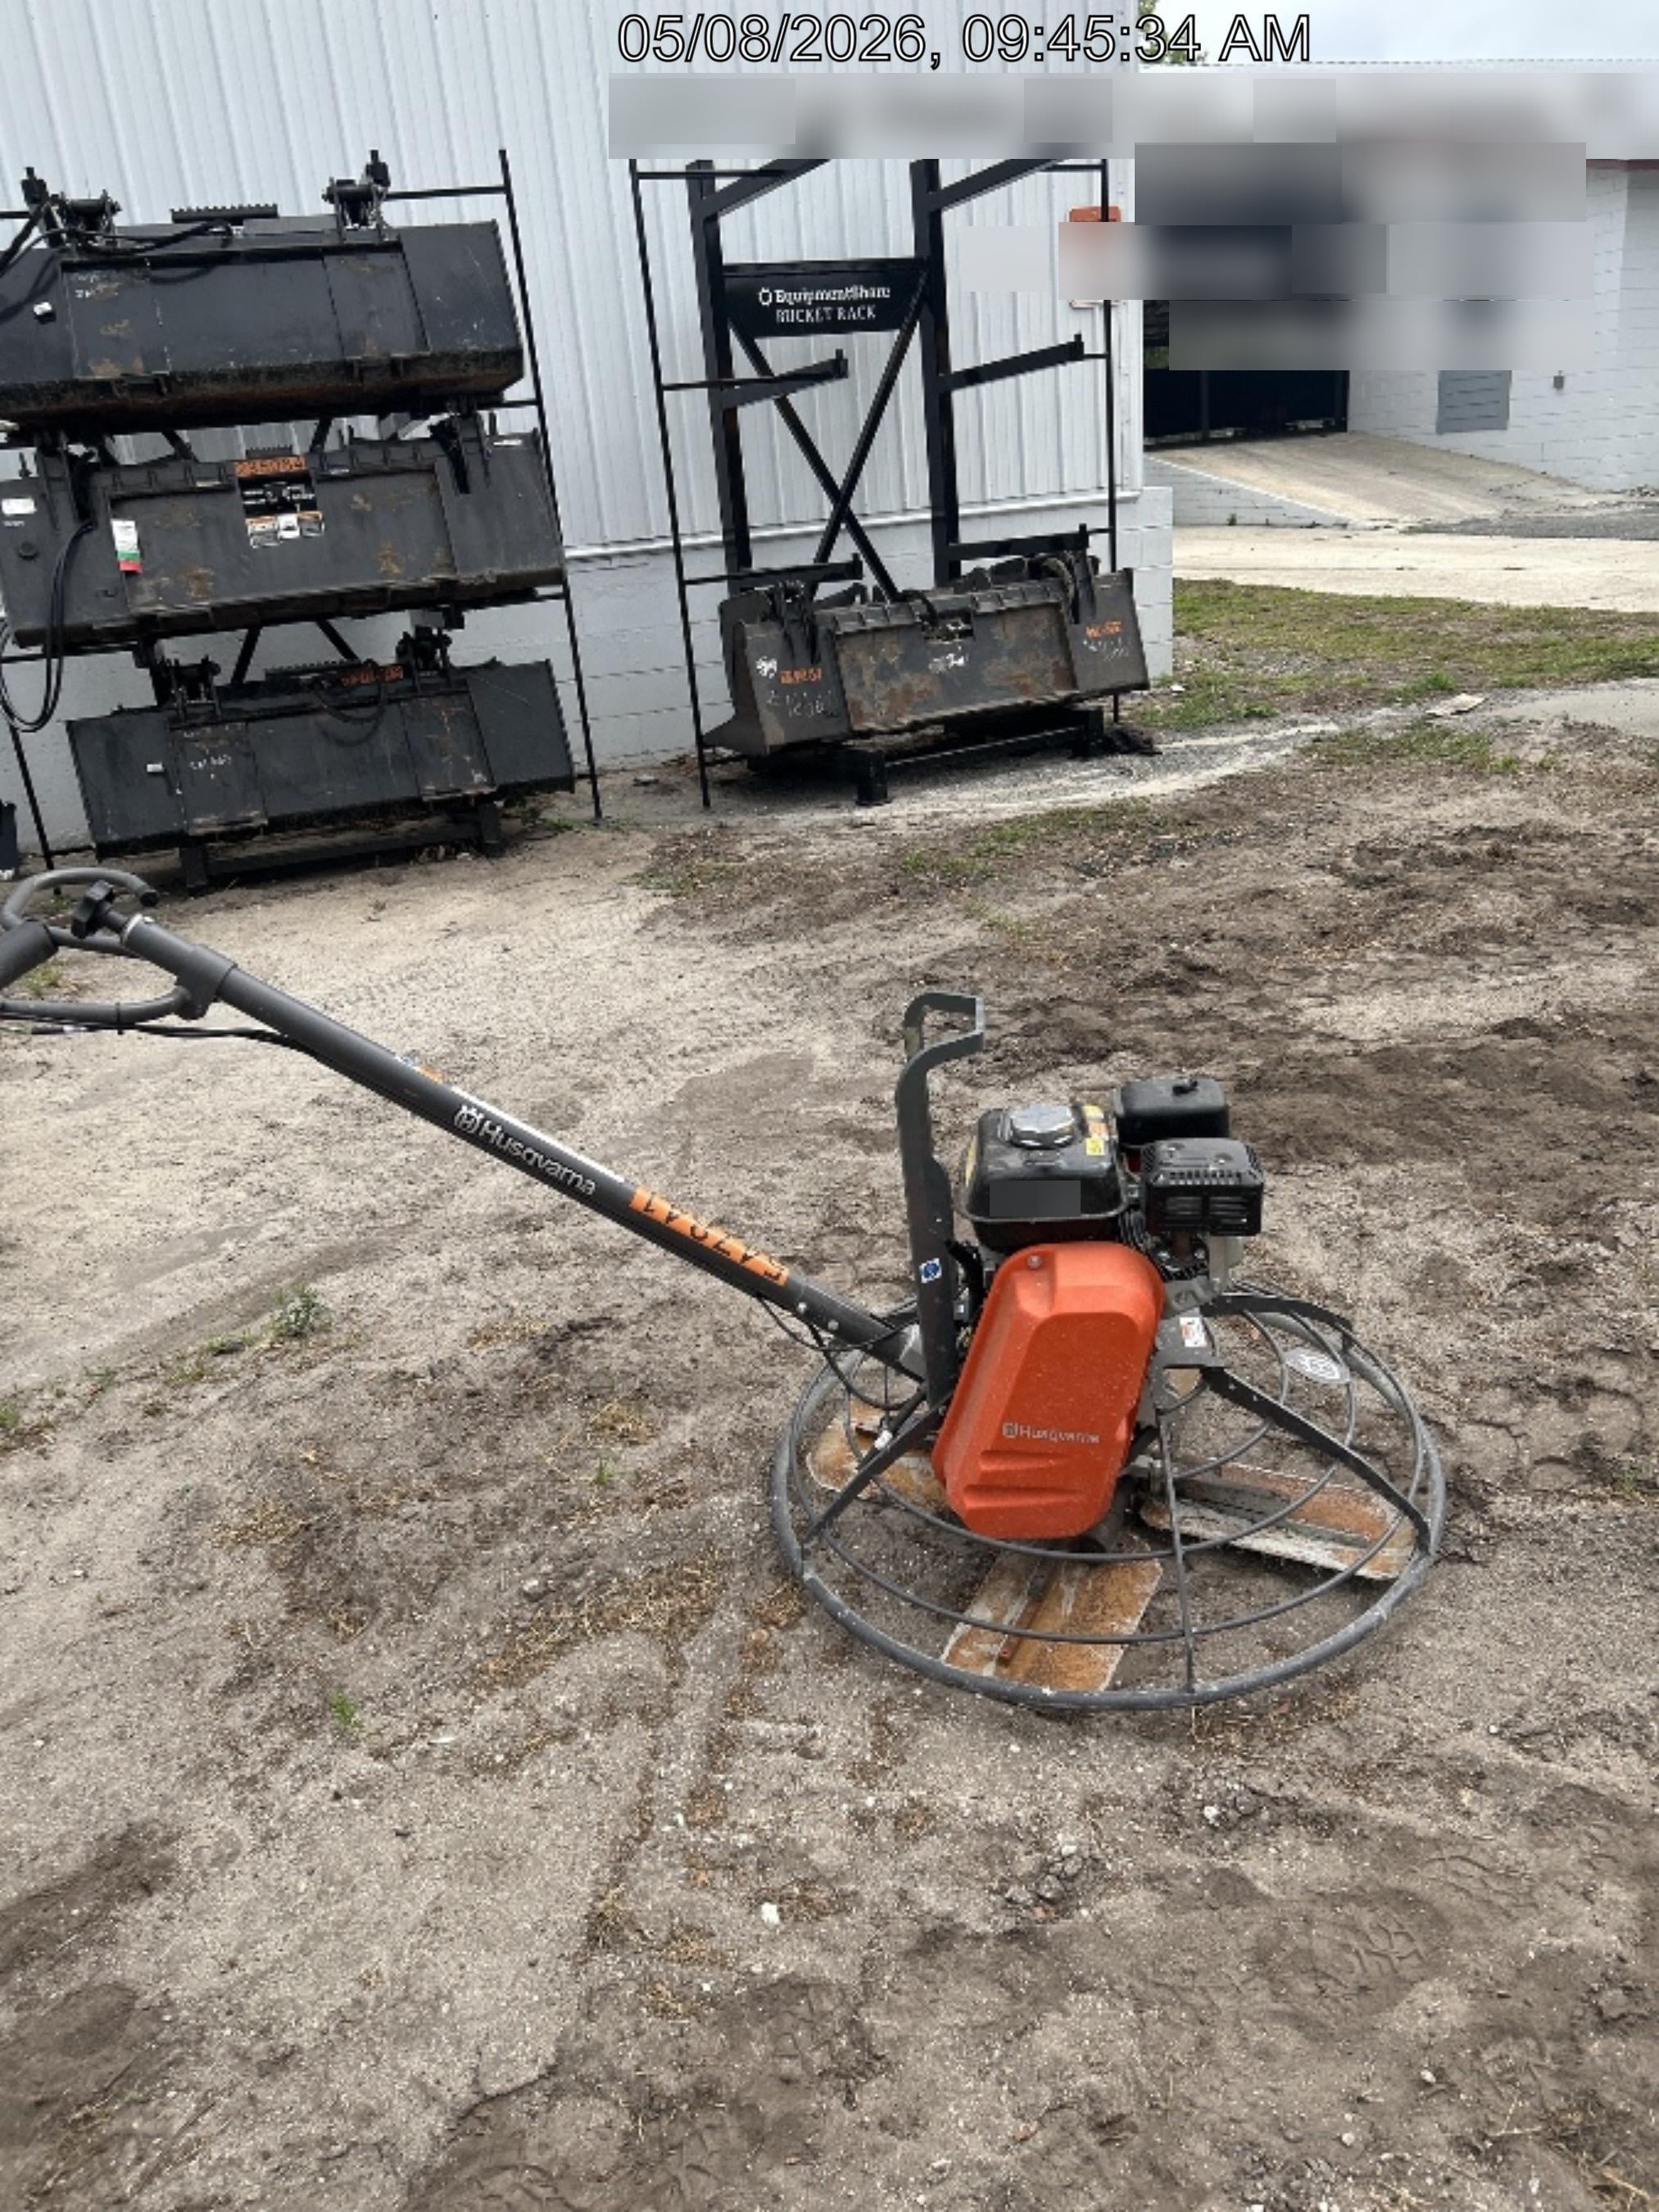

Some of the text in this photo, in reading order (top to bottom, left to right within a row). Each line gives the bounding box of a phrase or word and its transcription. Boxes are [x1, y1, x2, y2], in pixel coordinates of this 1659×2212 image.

[836, 304, 877, 321] RACK
[479, 1120, 596, 1195] Husqvarna
[1019, 1425, 1100, 1444] Husqvarna
